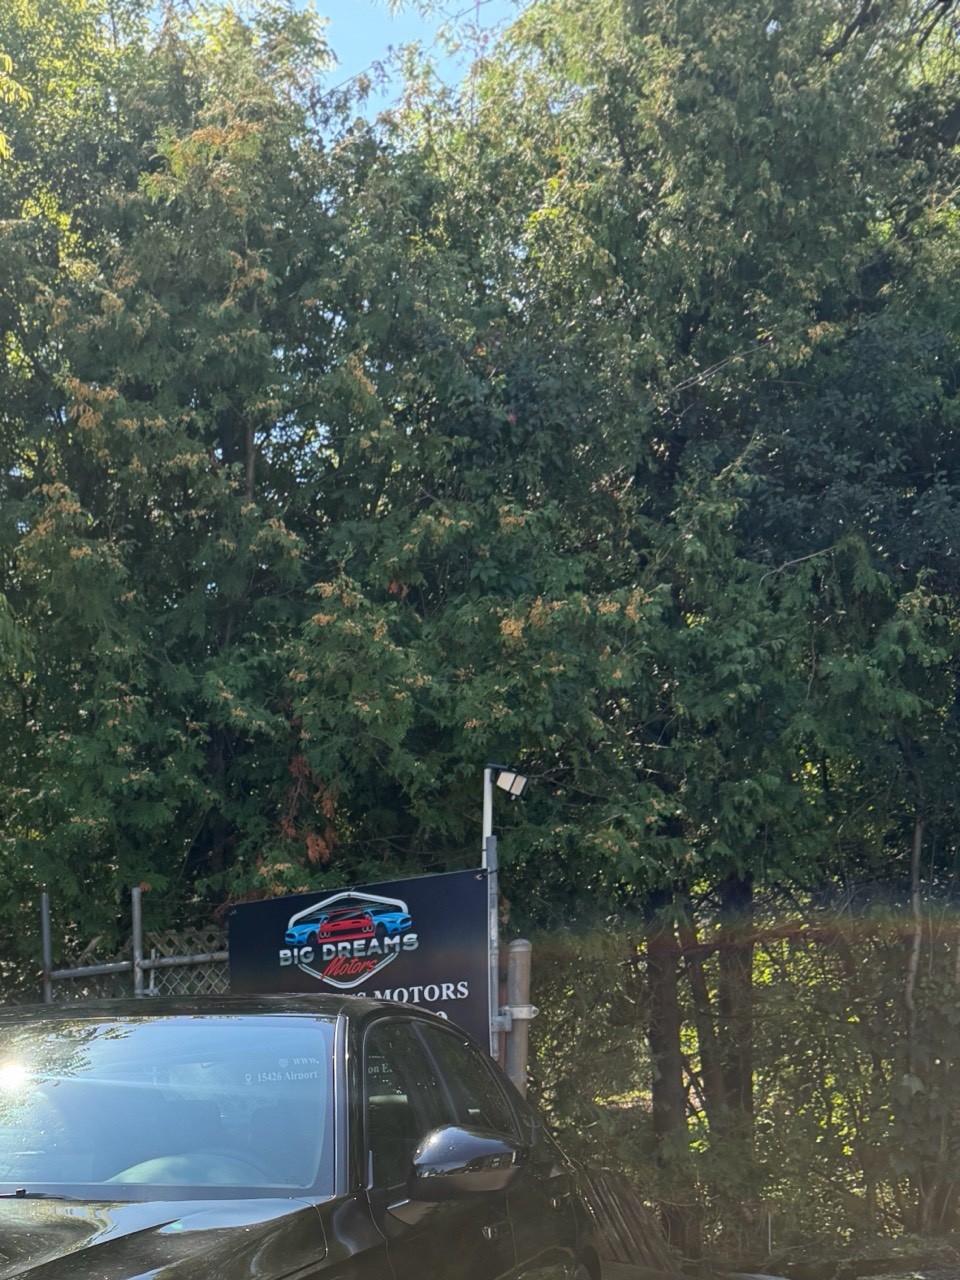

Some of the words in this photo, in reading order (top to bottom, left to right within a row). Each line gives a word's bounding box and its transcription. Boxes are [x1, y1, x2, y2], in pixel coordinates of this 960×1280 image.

[279, 947, 315, 966] BIG
[322, 933, 419, 961] DREAMS
[320, 957, 378, 980] Motors
[373, 981, 470, 1004] MOTORS
[257, 1071, 282, 1082] 15426
